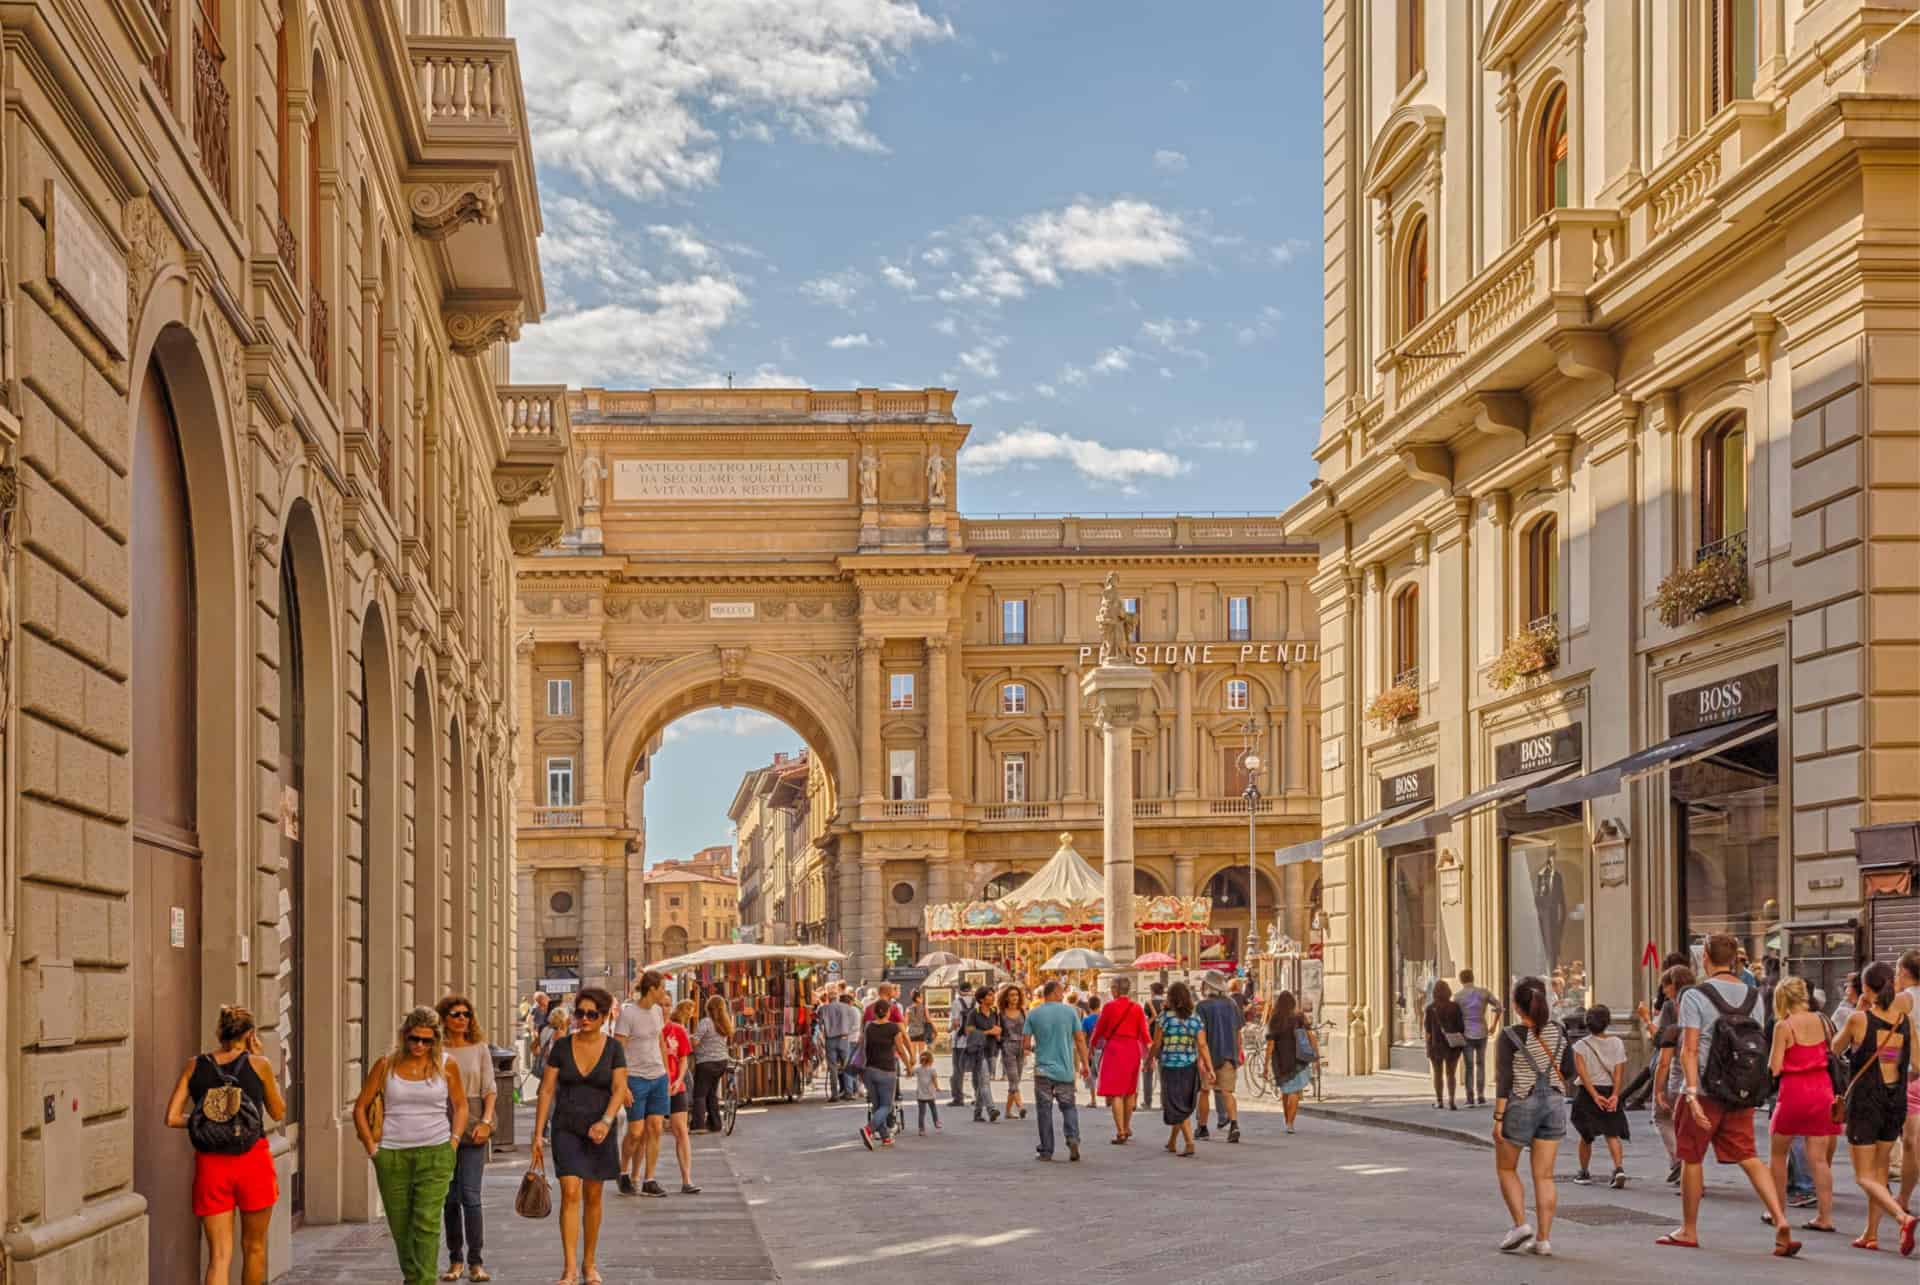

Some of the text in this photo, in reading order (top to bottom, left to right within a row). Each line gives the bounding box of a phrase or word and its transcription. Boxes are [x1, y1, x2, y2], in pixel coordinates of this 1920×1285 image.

[689, 462, 745, 473] CENTRO
[654, 484, 686, 496] VITA
[1079, 645, 1215, 665] PSIONE
[1700, 681, 1742, 714] BOSS
[1521, 736, 1551, 762] BOSS
[1395, 774, 1418, 795] BOSS
